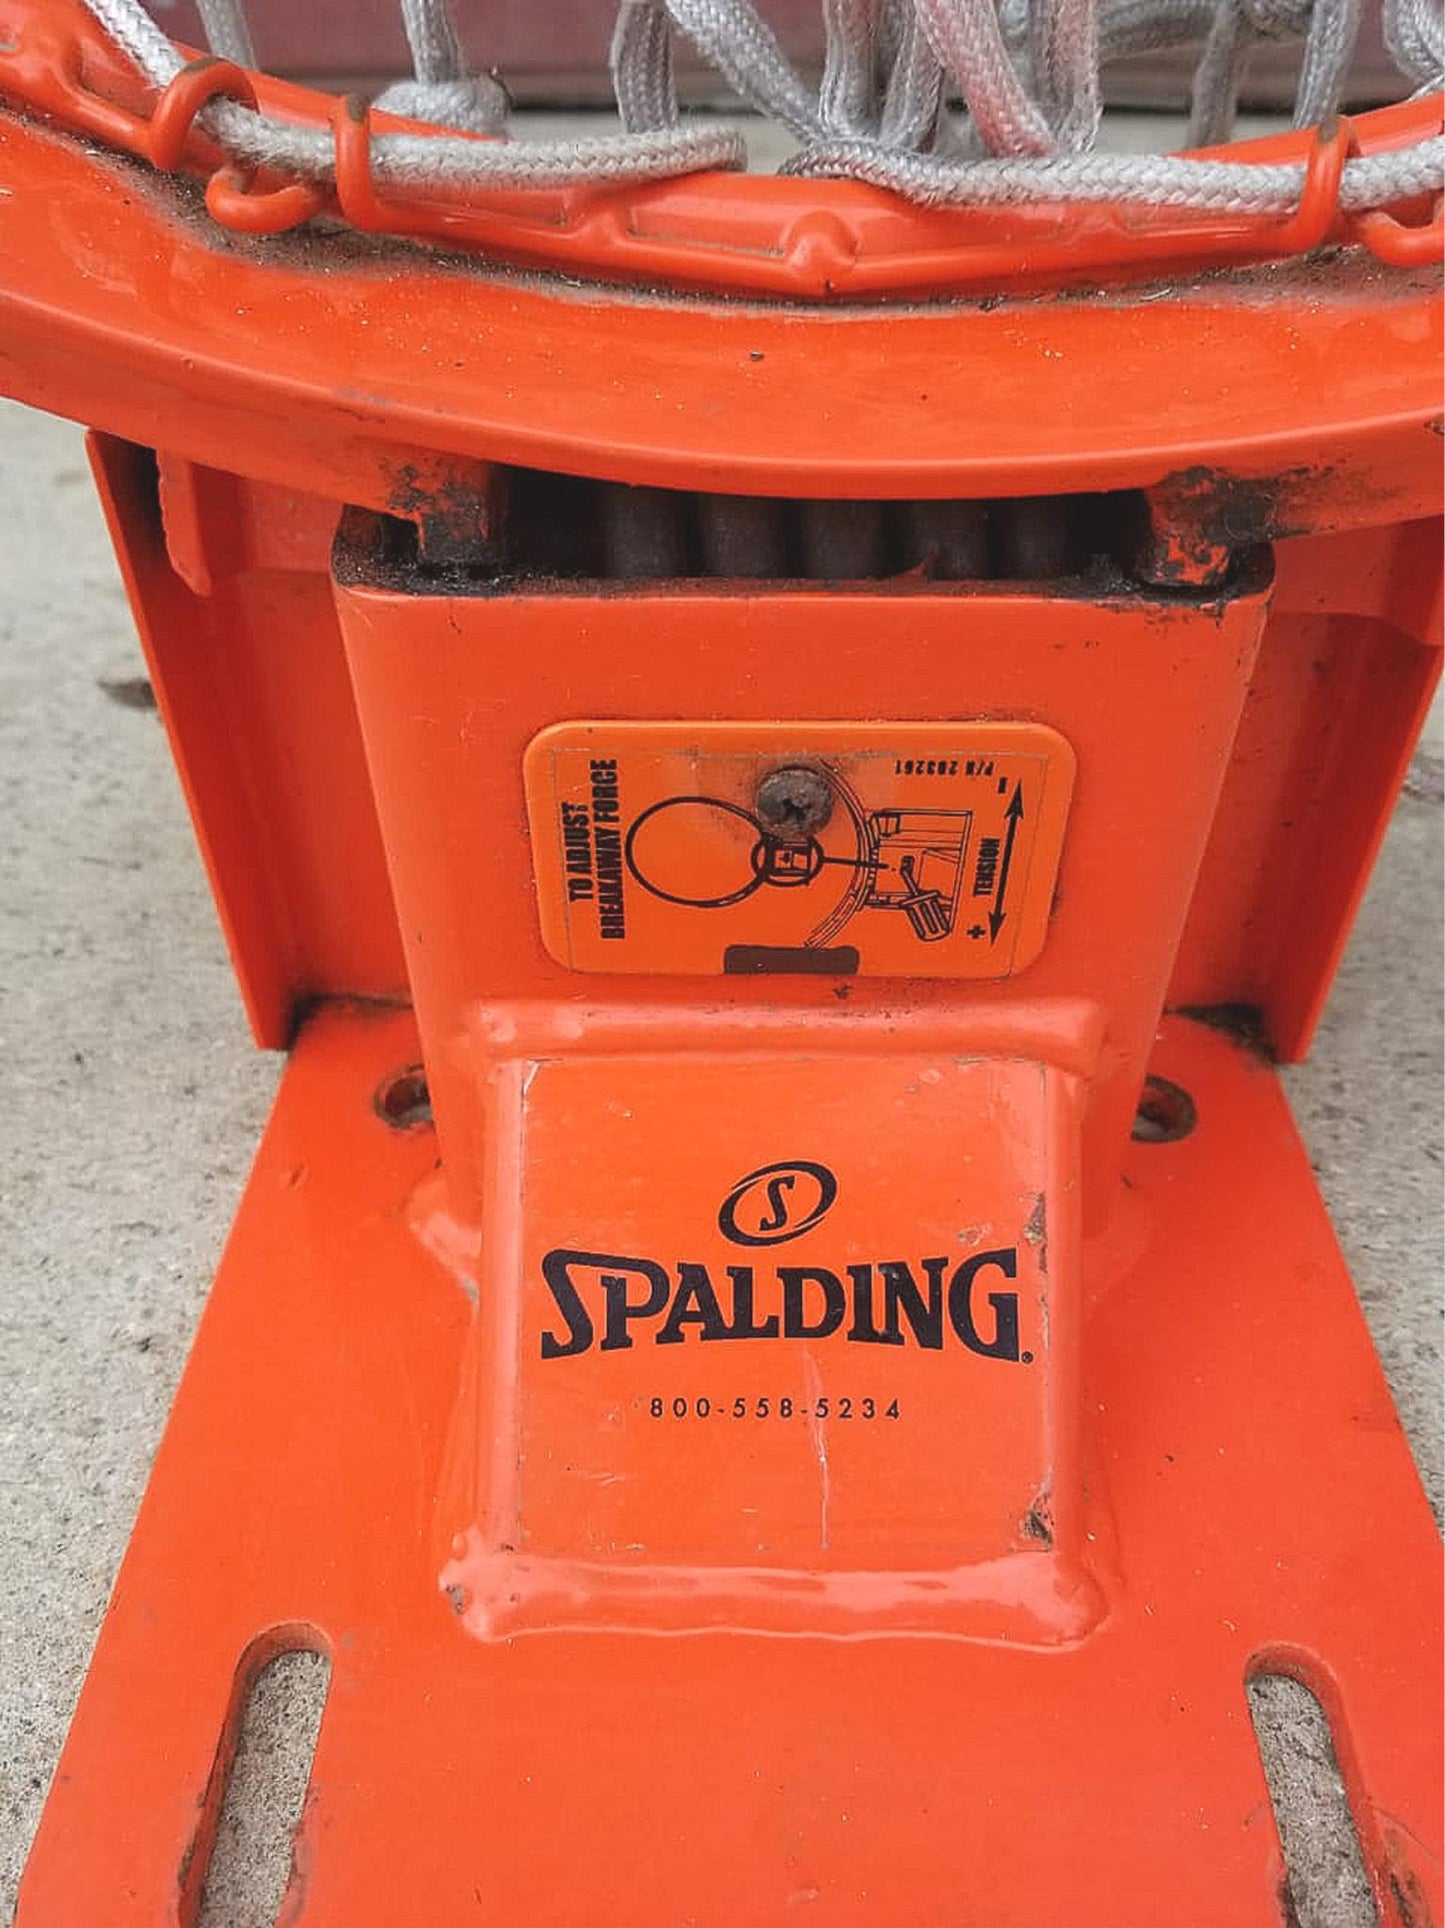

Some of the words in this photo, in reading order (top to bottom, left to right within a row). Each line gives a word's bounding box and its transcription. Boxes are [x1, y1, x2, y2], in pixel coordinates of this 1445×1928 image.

[590, 759, 619, 823] FORCE
[965, 760, 994, 776] P/N
[561, 802, 592, 874] ADJUST
[973, 838, 1000, 897] TENSION
[568, 878, 594, 902] TO
[595, 826, 625, 939] BREAKAWAY
[760, 1176, 796, 1232] S
[541, 1248, 1019, 1363] SPALDING
[650, 1397, 901, 1420] 800-558-5234
